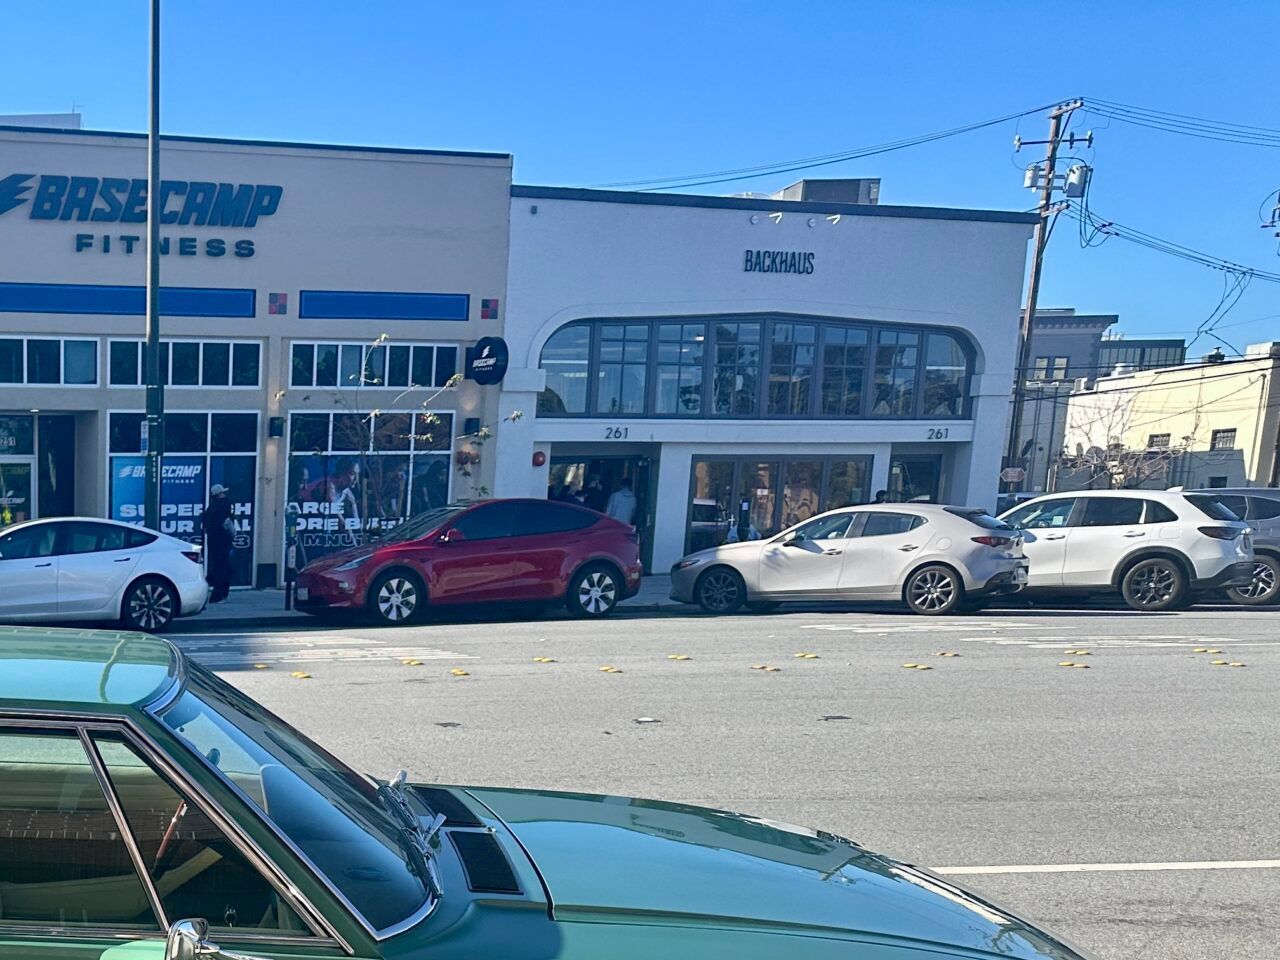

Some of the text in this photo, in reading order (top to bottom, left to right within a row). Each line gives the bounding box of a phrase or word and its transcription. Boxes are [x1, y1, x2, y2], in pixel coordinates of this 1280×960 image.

[29, 174, 284, 228] BASECAMP
[76, 233, 256, 258] FITNESS
[743, 249, 815, 275] BACKHAUS
[605, 426, 629, 440] 261
[927, 427, 950, 440] 261
